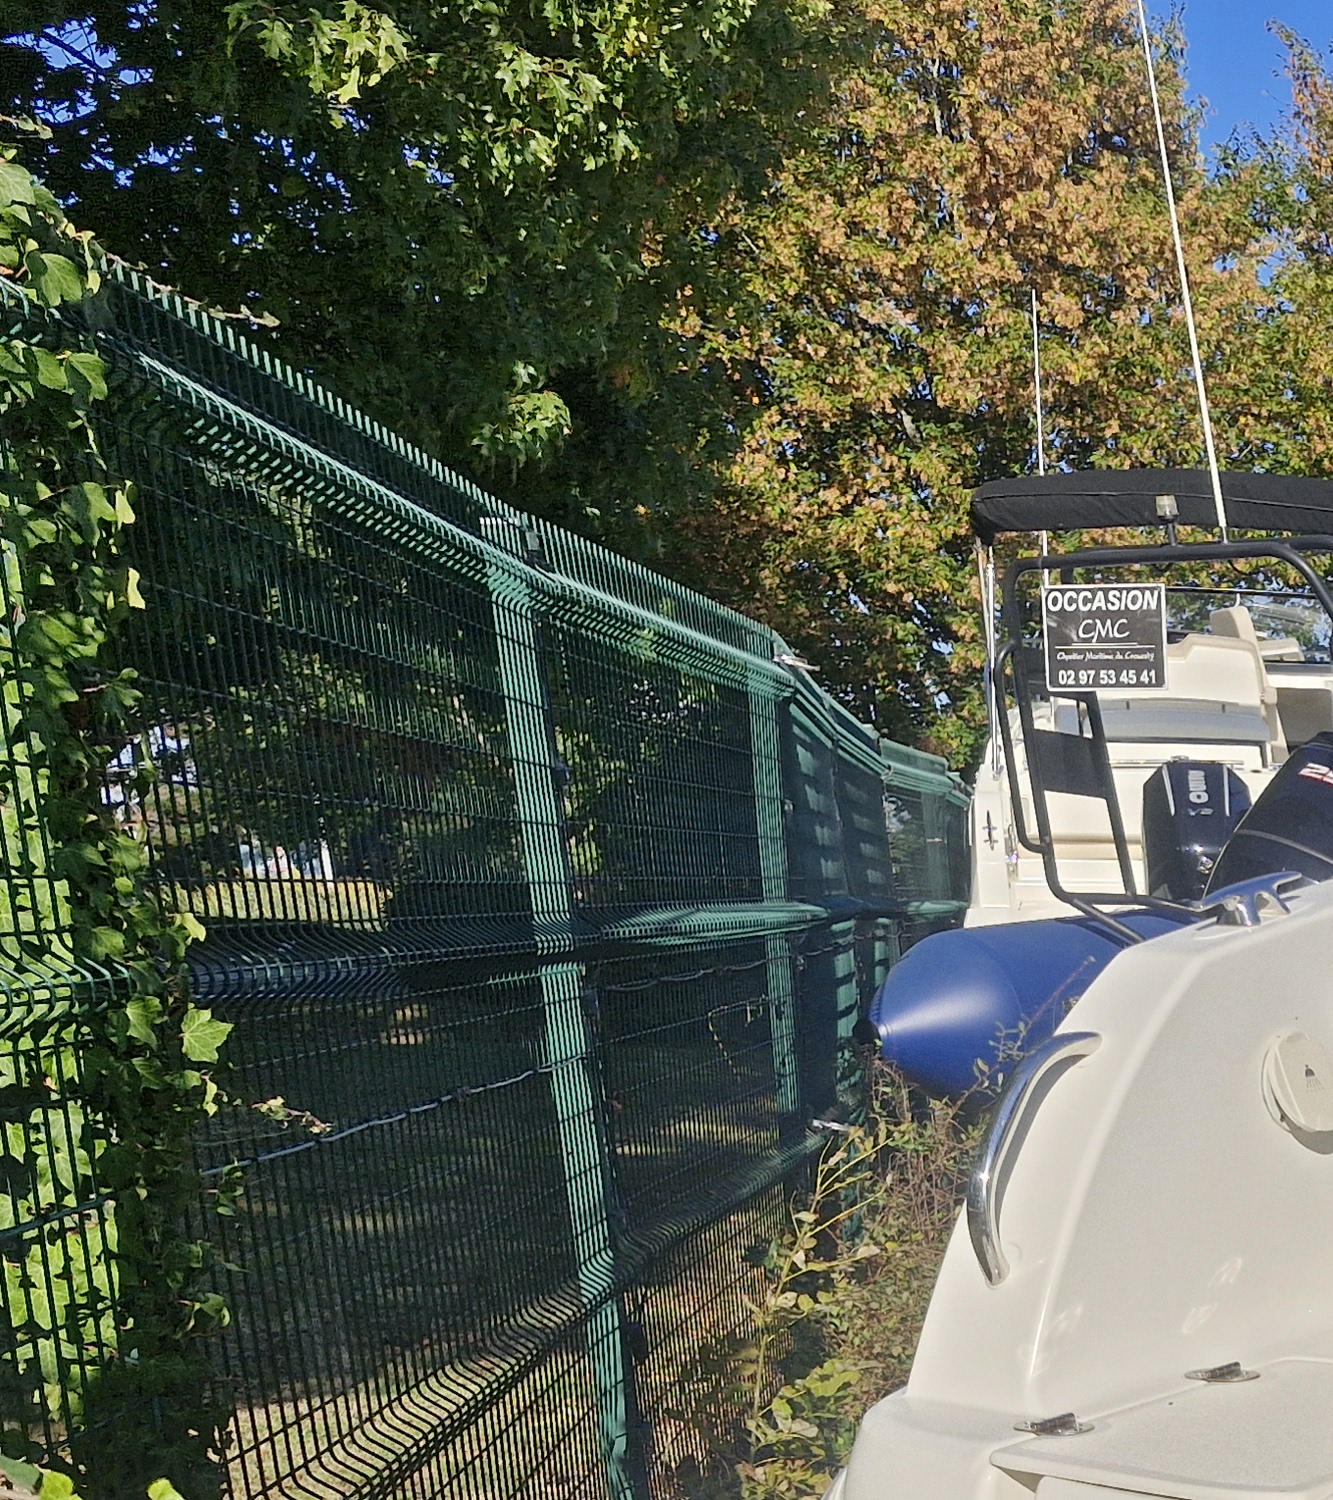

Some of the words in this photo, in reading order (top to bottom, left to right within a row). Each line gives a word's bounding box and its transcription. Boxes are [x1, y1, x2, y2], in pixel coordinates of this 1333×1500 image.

[1046, 589, 1159, 612] OCCASION
[1078, 618, 1131, 643] CMC
[1058, 669, 1076, 685] 02
[1079, 669, 1095, 685] 97
[1099, 669, 1116, 685] 53
[1119, 669, 1137, 685] 45
[1139, 669, 1156, 685] 41
